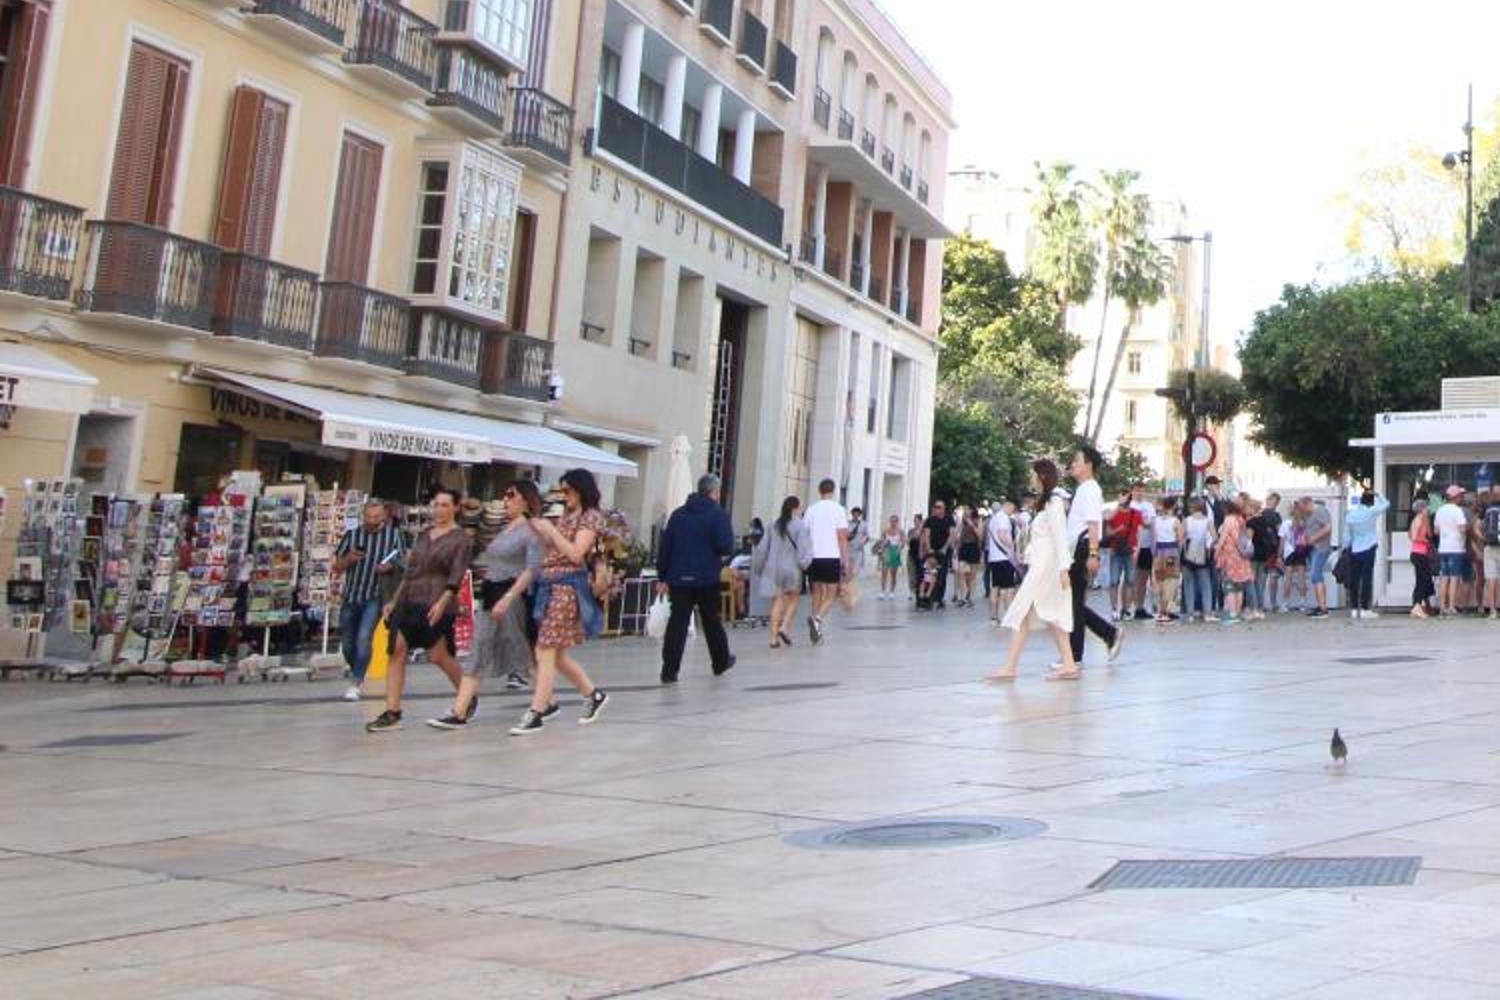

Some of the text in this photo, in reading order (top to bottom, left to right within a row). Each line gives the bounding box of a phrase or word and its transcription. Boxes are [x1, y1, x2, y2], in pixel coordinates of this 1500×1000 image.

[590, 164, 777, 281] ESTUDIANTES
[368, 431, 399, 451] VINOS
[400, 434, 413, 452] DE
